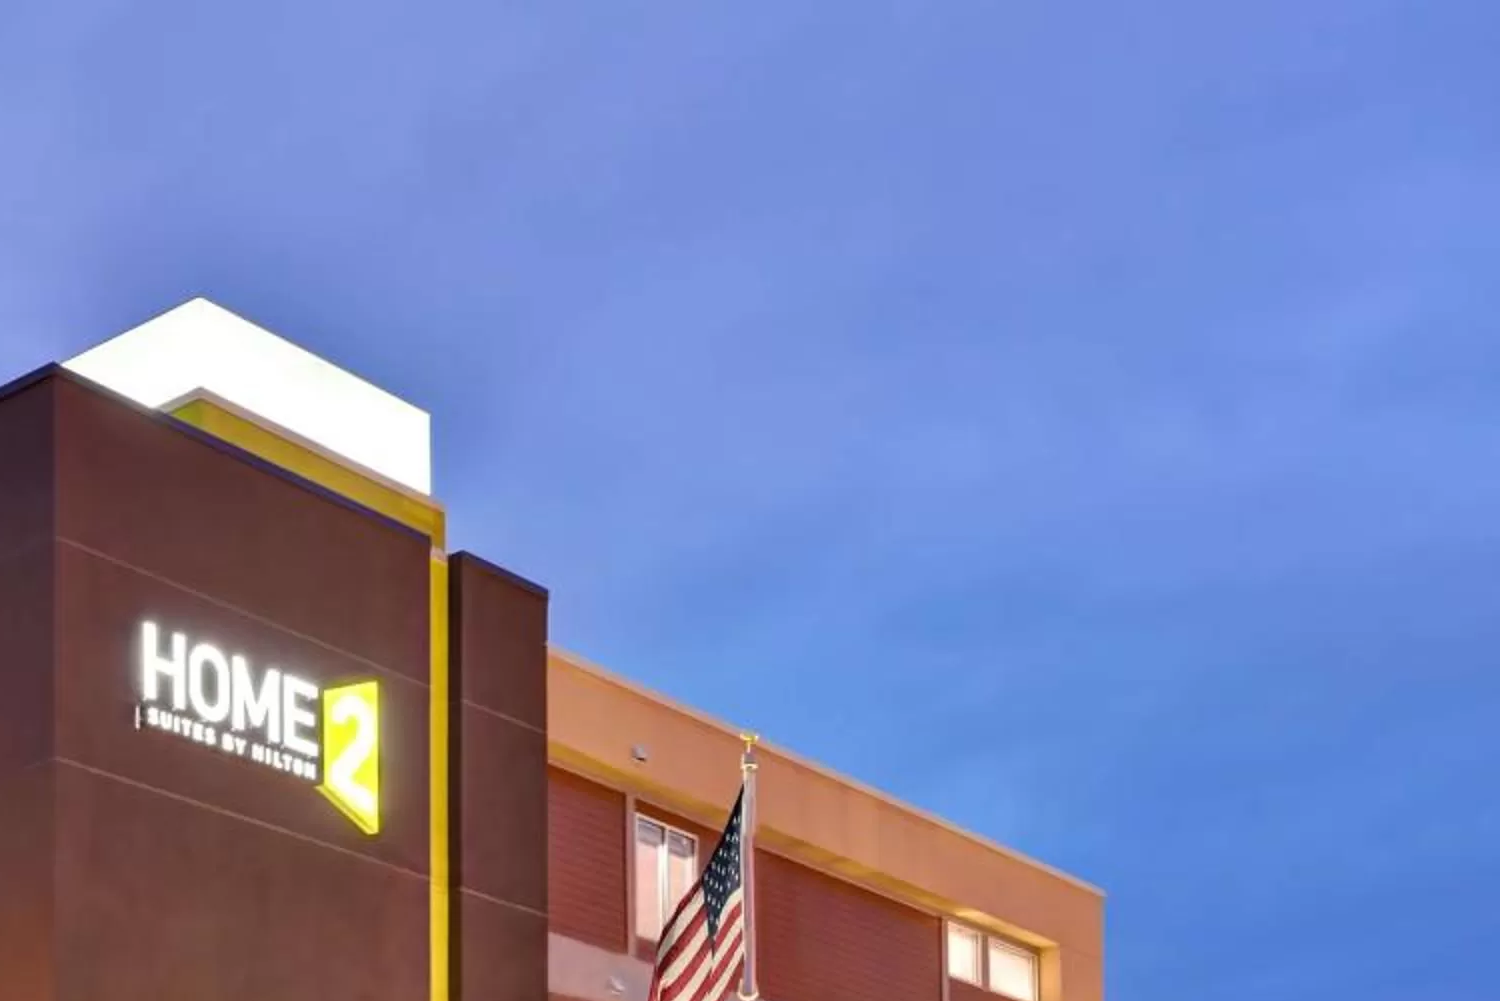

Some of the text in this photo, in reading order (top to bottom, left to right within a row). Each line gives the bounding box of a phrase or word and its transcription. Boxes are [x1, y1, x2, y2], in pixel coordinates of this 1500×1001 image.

[142, 620, 319, 757] HOME
[147, 706, 317, 780] SUITES BY HILTON
